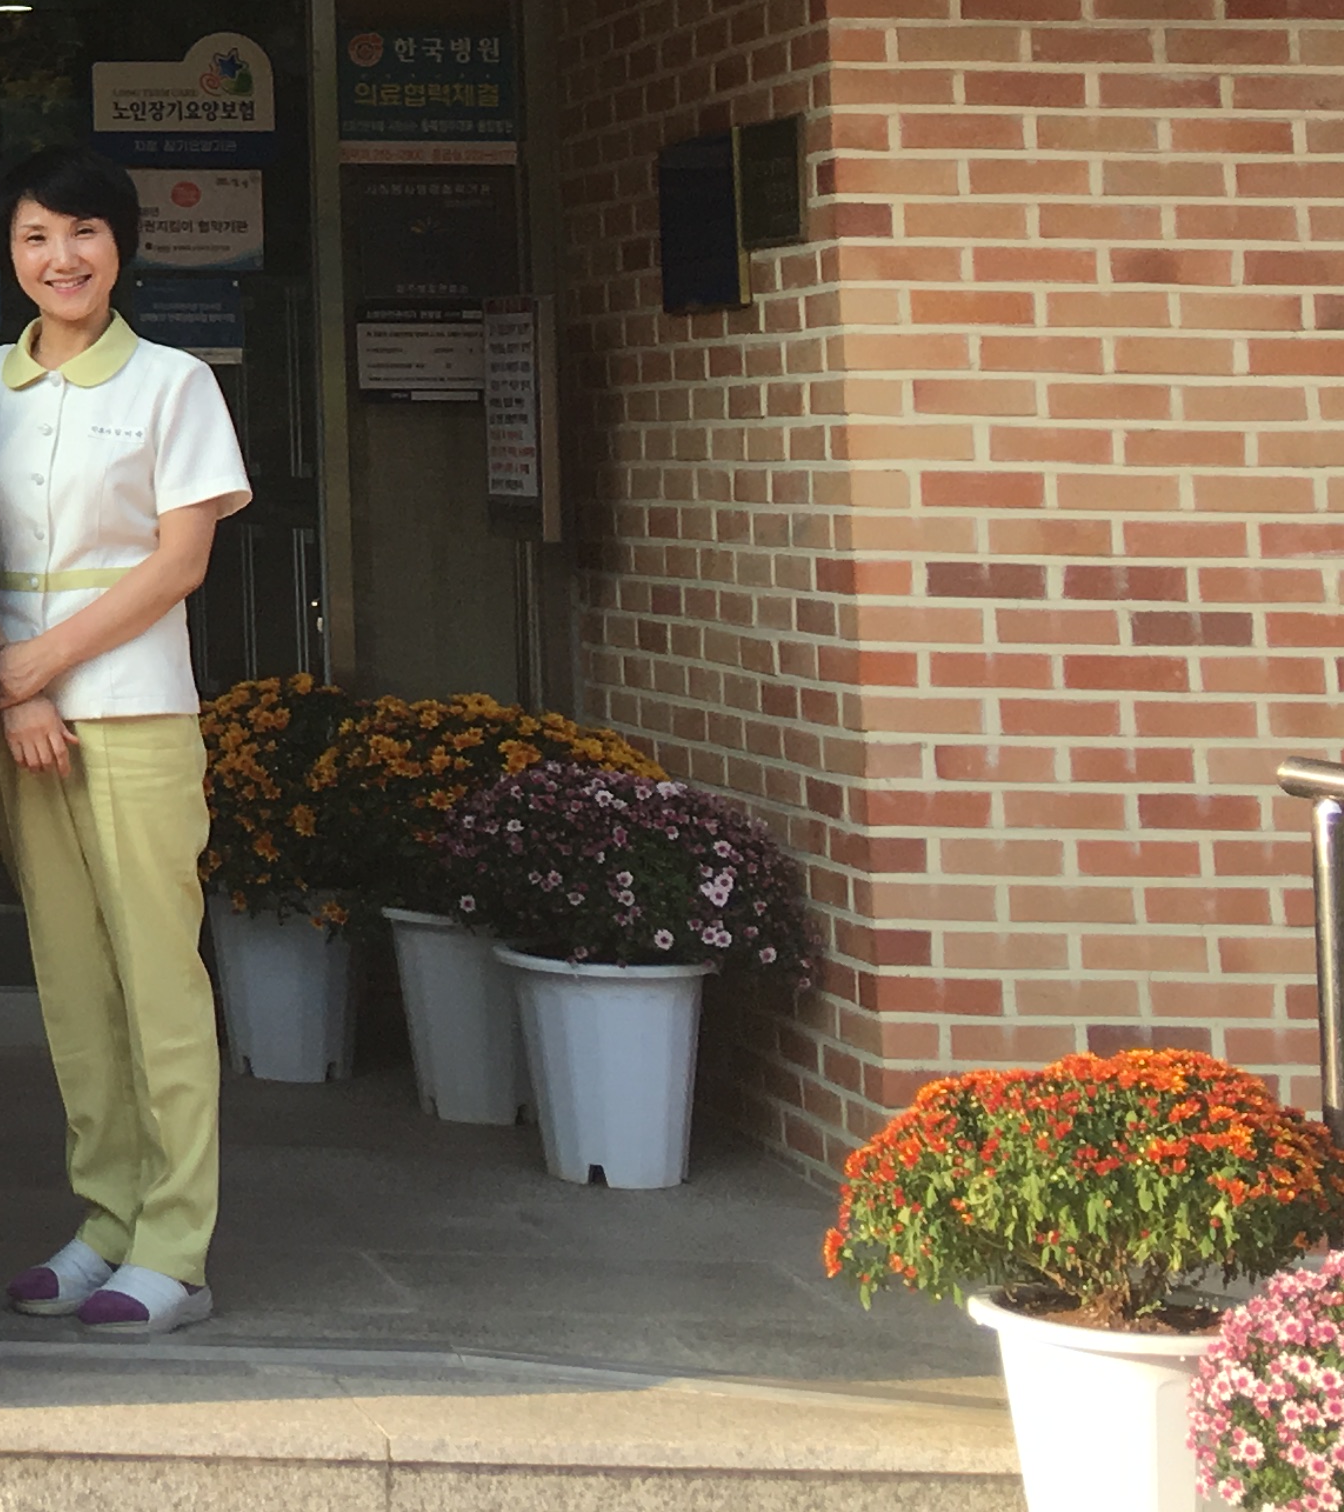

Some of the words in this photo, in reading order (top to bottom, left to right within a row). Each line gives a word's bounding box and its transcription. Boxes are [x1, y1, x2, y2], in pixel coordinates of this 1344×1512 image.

[394, 37, 501, 63] 한국병원
[353, 82, 500, 107] 의료협력체결
[113, 100, 256, 122] 노인장기요양보험
